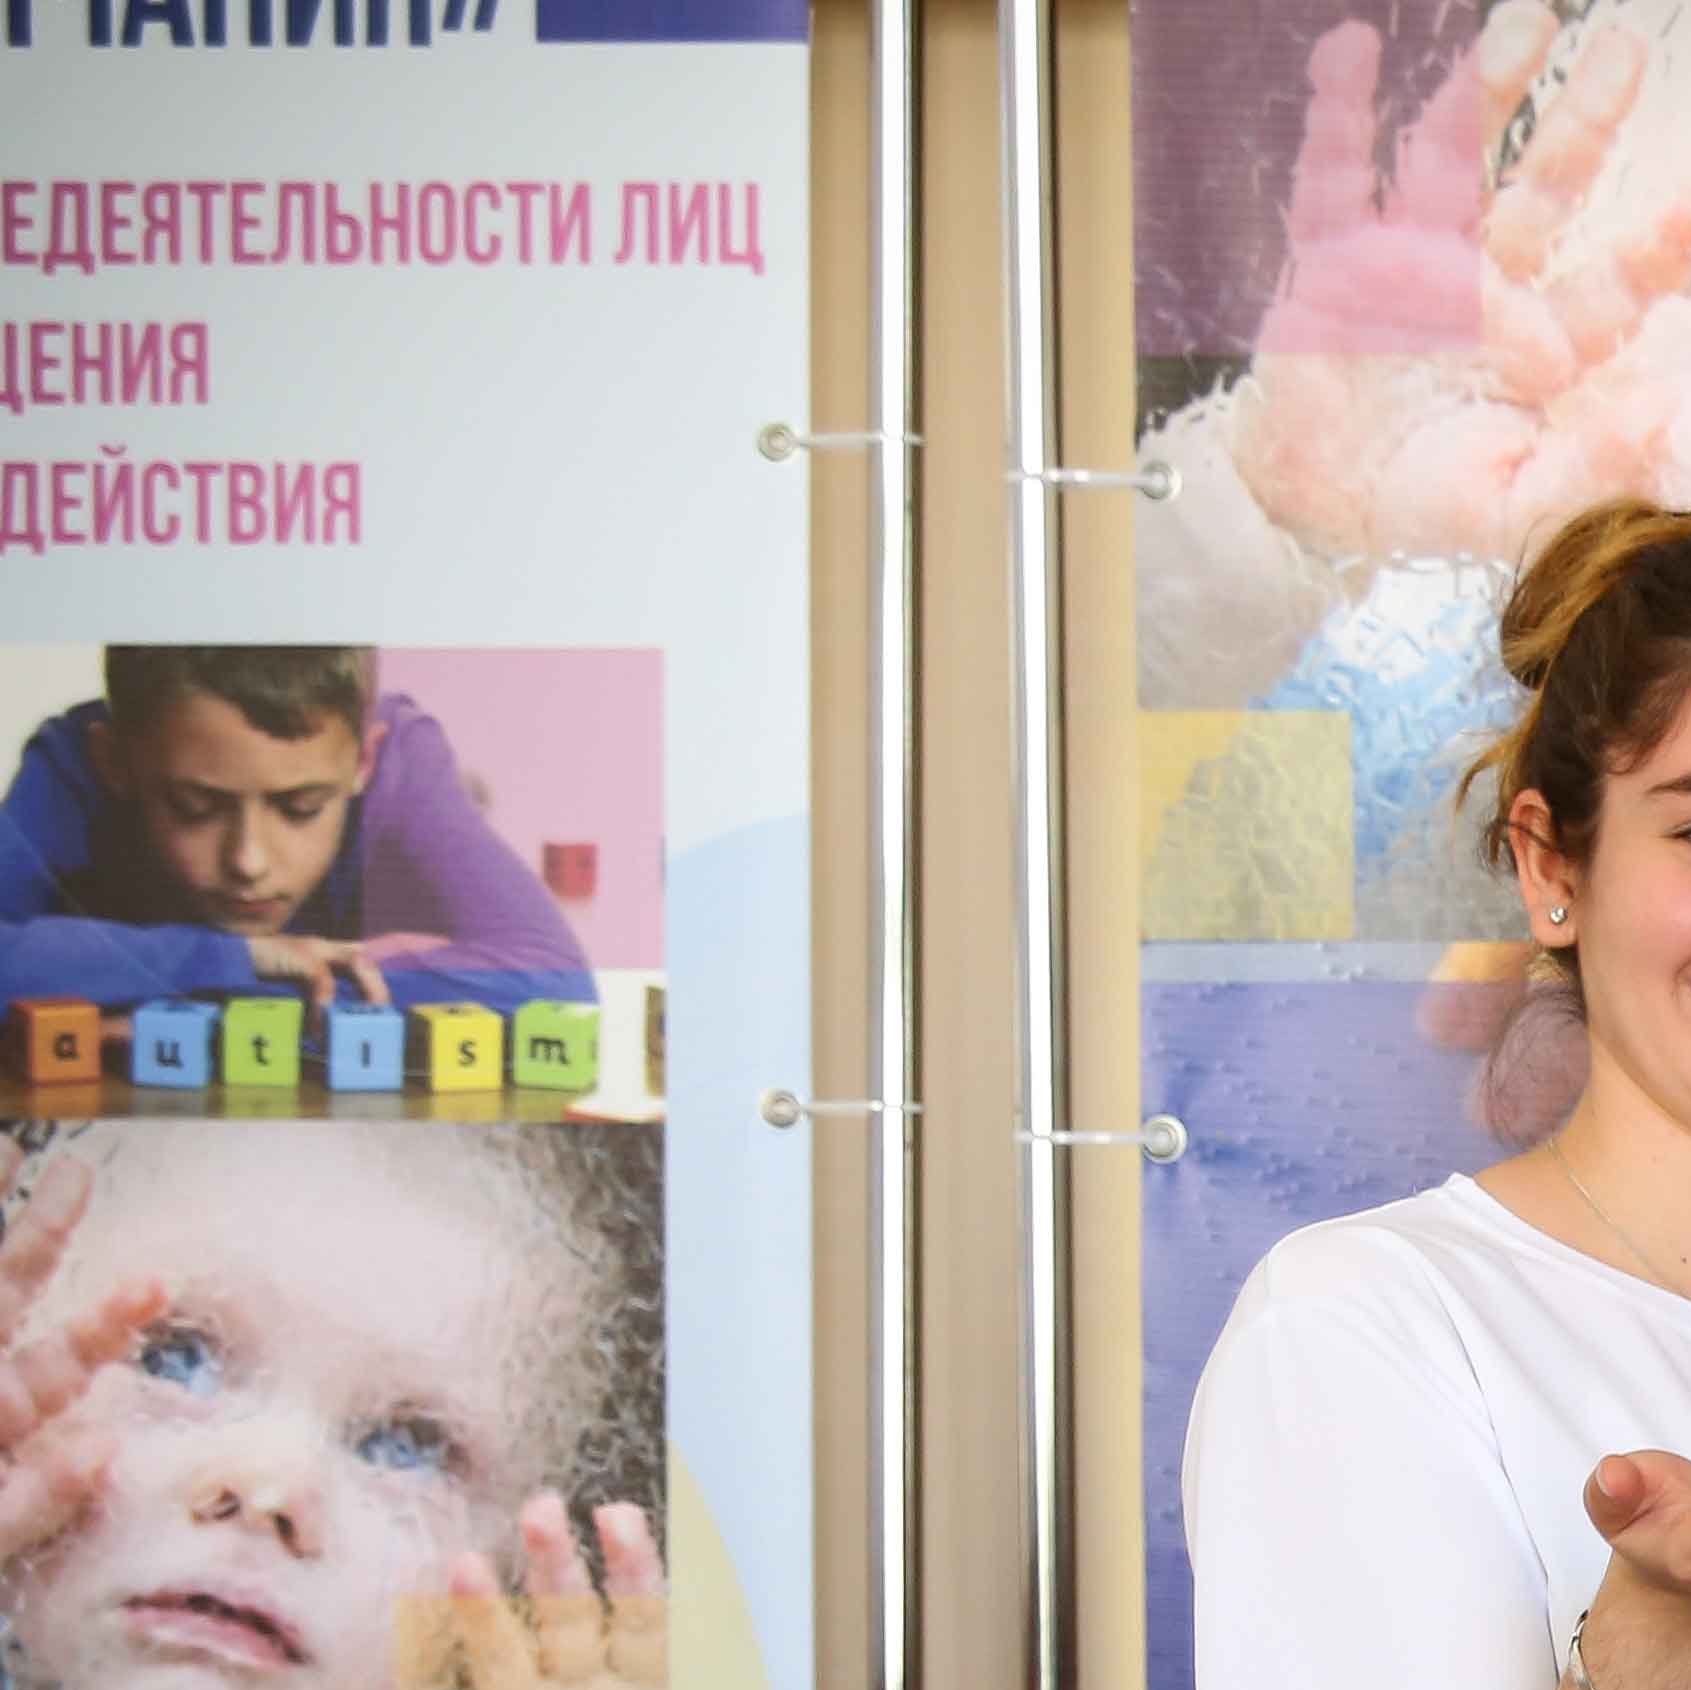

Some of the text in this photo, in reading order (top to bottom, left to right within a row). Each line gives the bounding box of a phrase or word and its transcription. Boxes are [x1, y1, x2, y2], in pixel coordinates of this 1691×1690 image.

[1, 180, 766, 275] ЕДЕЯТЕЛЬНОСТИ ЛИЦ
[0, 444, 361, 555] ДЕЙСТВИЯ
